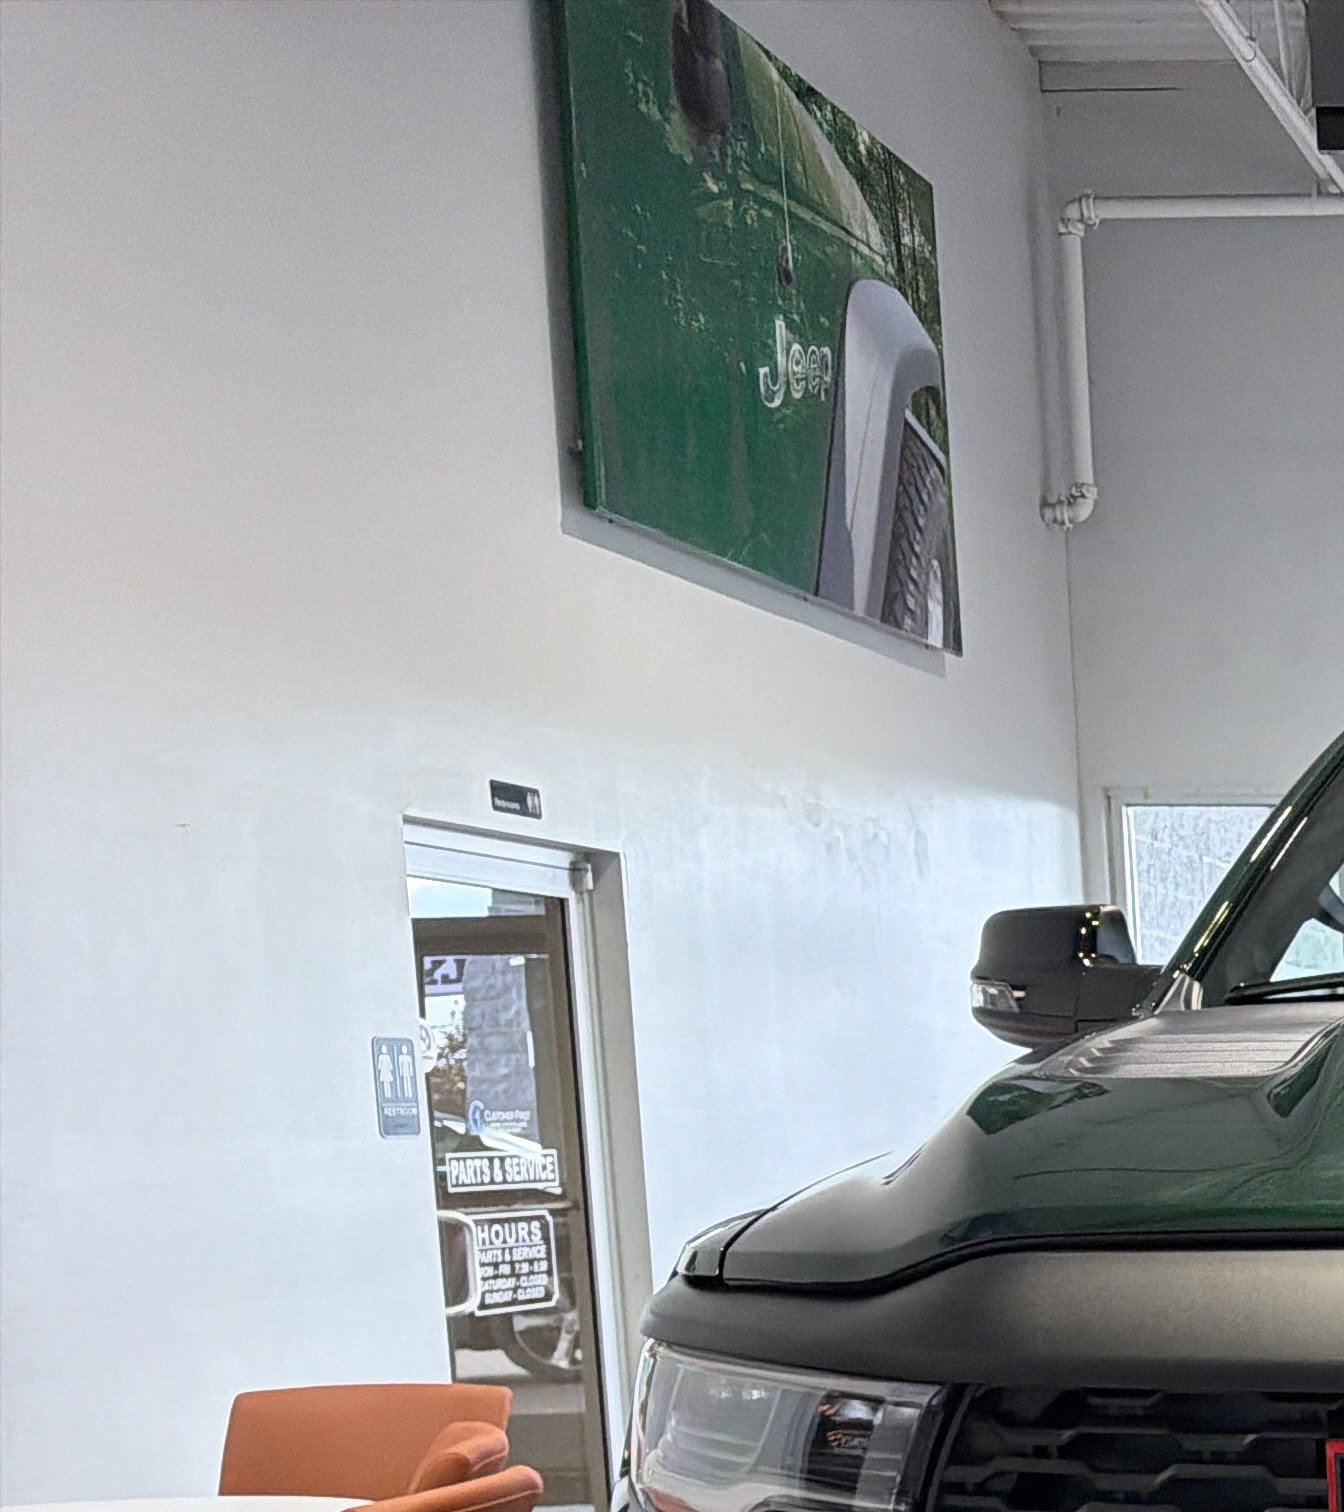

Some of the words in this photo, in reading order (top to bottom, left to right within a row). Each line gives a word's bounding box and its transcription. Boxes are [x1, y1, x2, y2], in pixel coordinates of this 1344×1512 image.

[758, 315, 832, 408] Jeep
[450, 1158, 490, 1185] PARTS
[493, 1158, 503, 1183] &
[505, 1155, 556, 1182] SERVICE
[478, 1221, 542, 1246] HOURS
